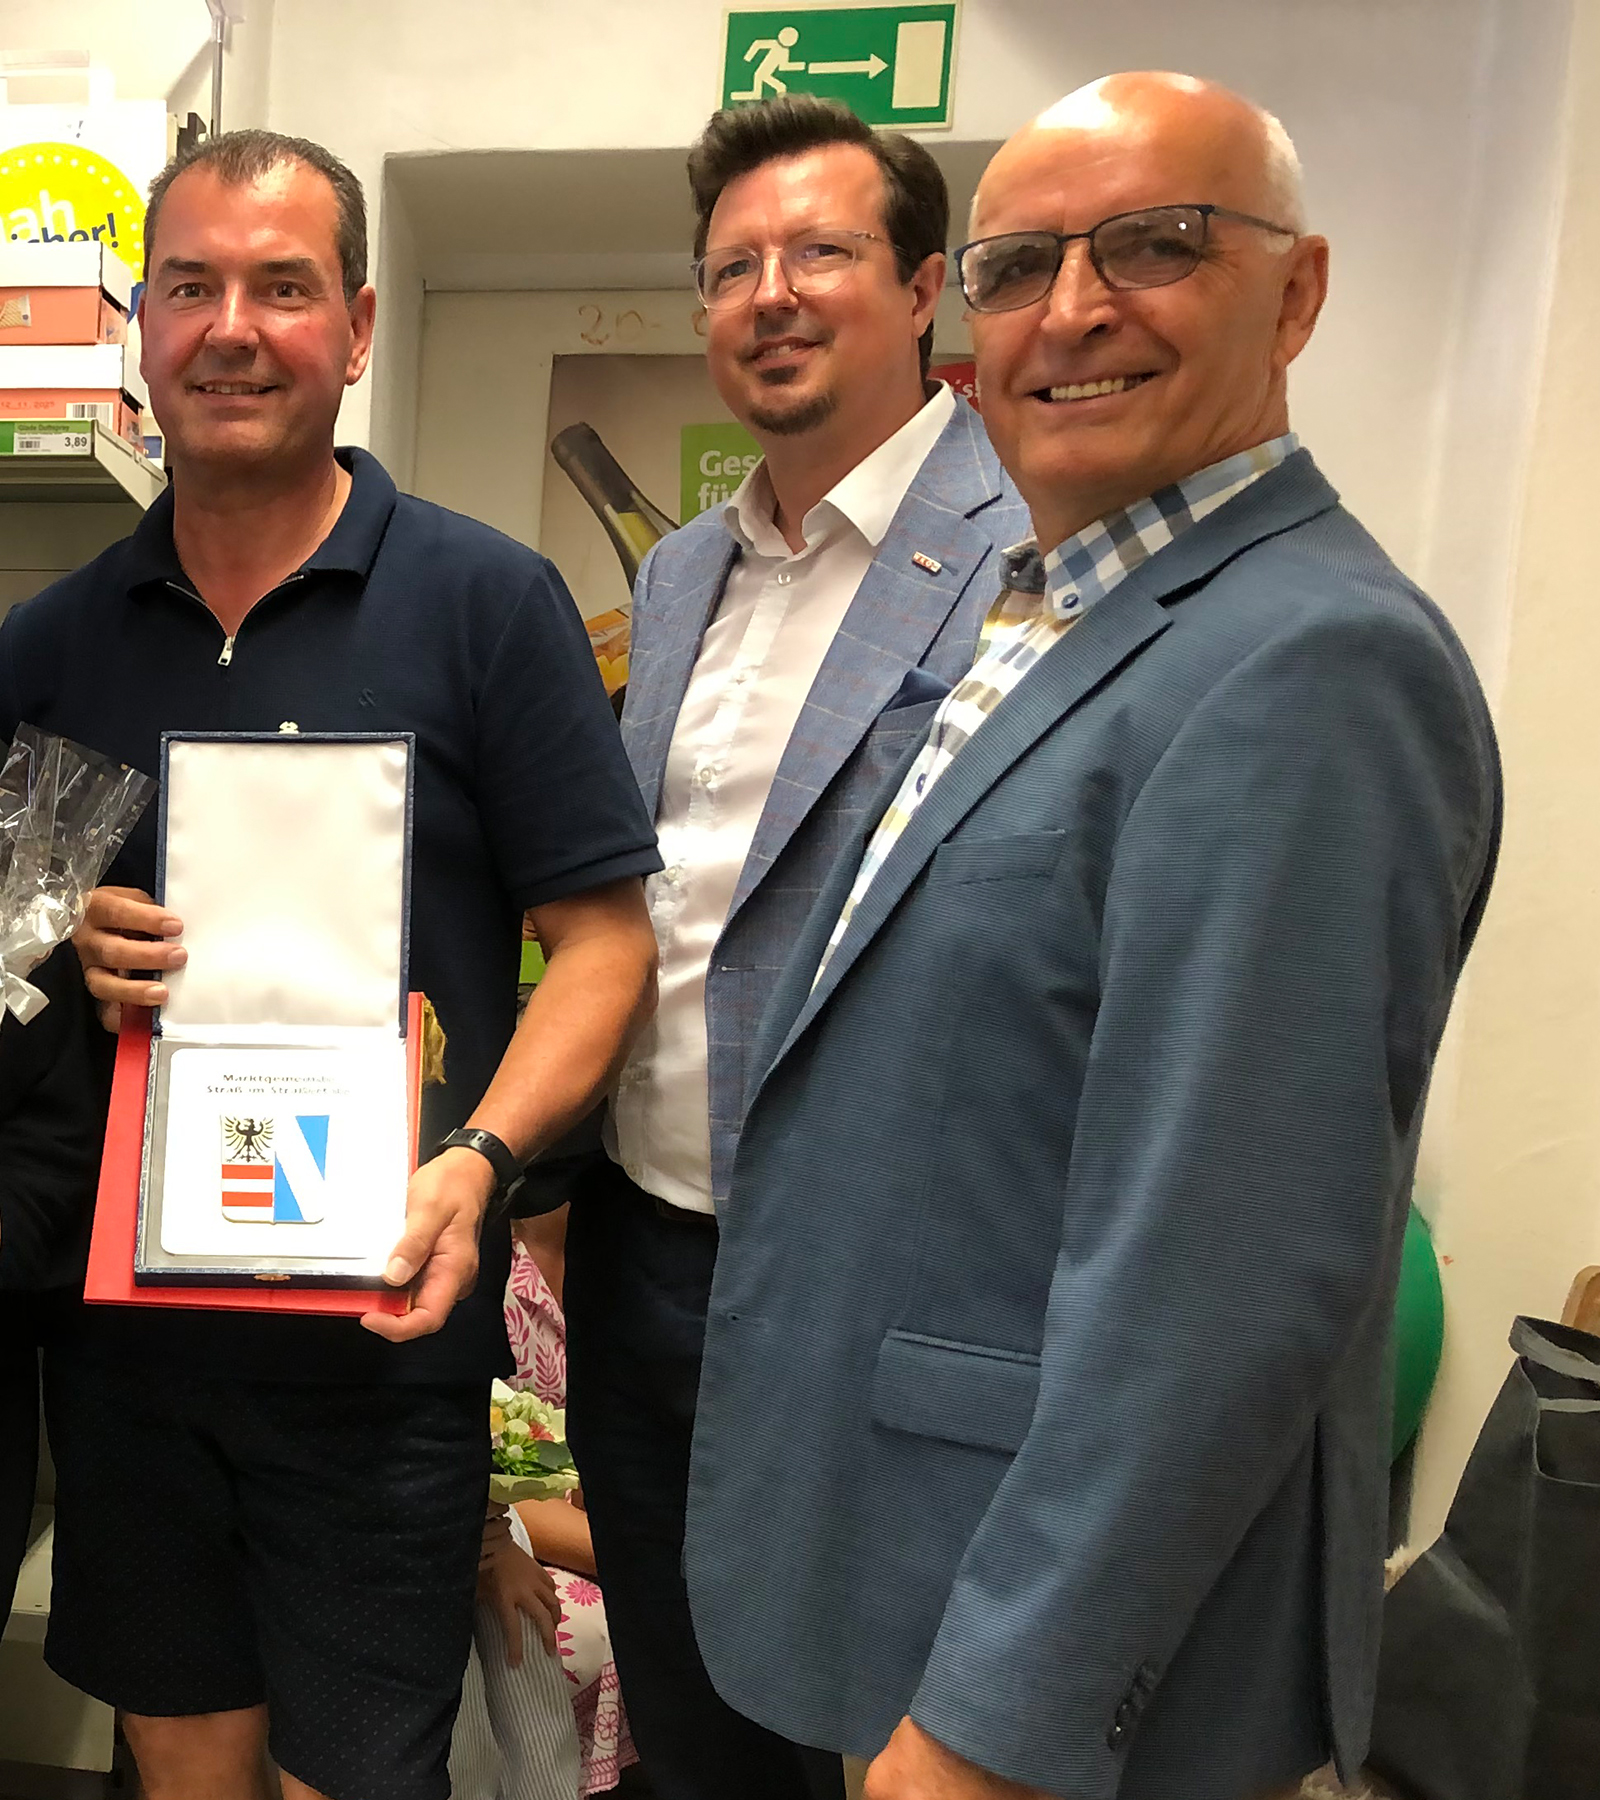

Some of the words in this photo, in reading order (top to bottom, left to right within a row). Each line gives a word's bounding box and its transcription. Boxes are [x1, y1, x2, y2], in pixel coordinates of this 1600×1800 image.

[64, 436, 88, 449] 3,89
[699, 449, 756, 477] Ges
[698, 482, 736, 511] fü
